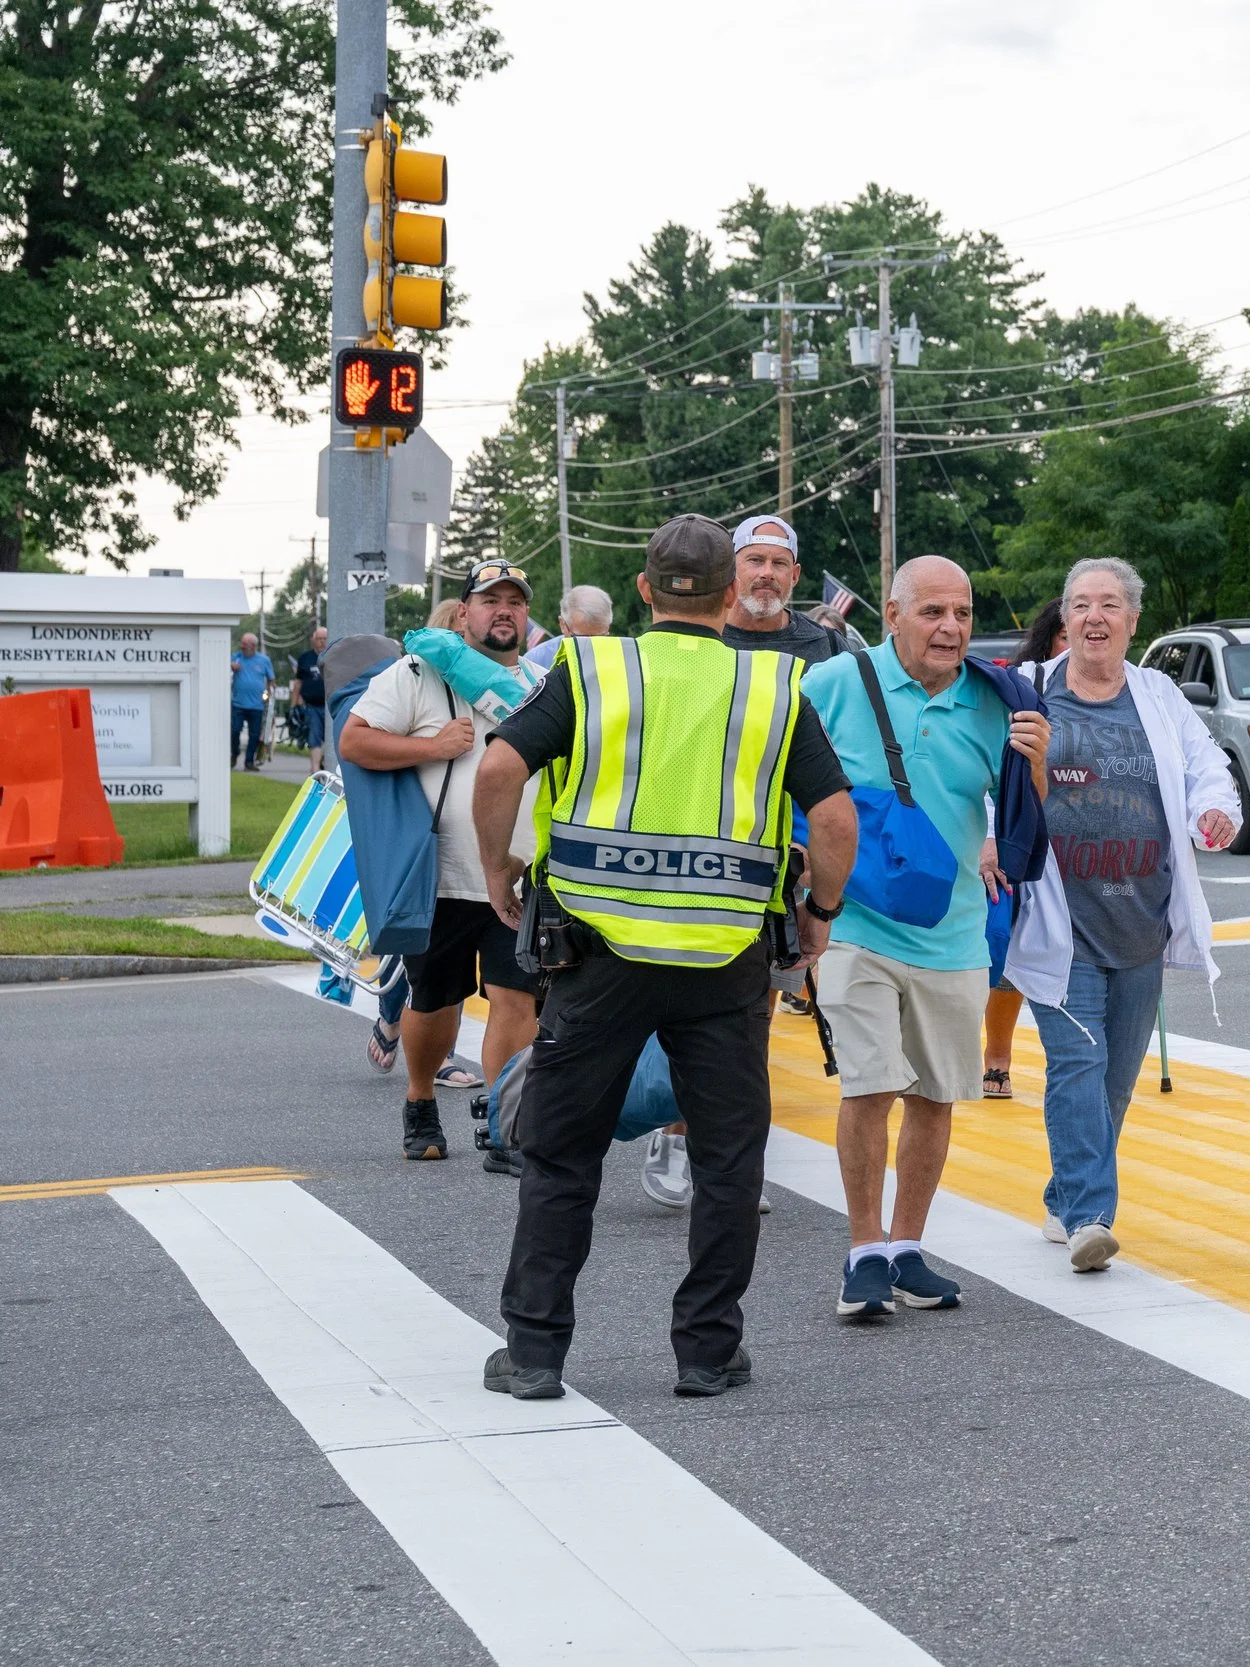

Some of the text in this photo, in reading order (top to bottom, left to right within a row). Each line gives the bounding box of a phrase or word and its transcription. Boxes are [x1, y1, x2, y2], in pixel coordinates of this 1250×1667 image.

[31, 625, 154, 641] LONDONDERRY
[0, 647, 191, 662] RESBYTERIAN CHURCH
[1053, 769, 1088, 783] WAY
[1096, 755, 1158, 785] YOUR
[595, 844, 742, 881] POLICE
